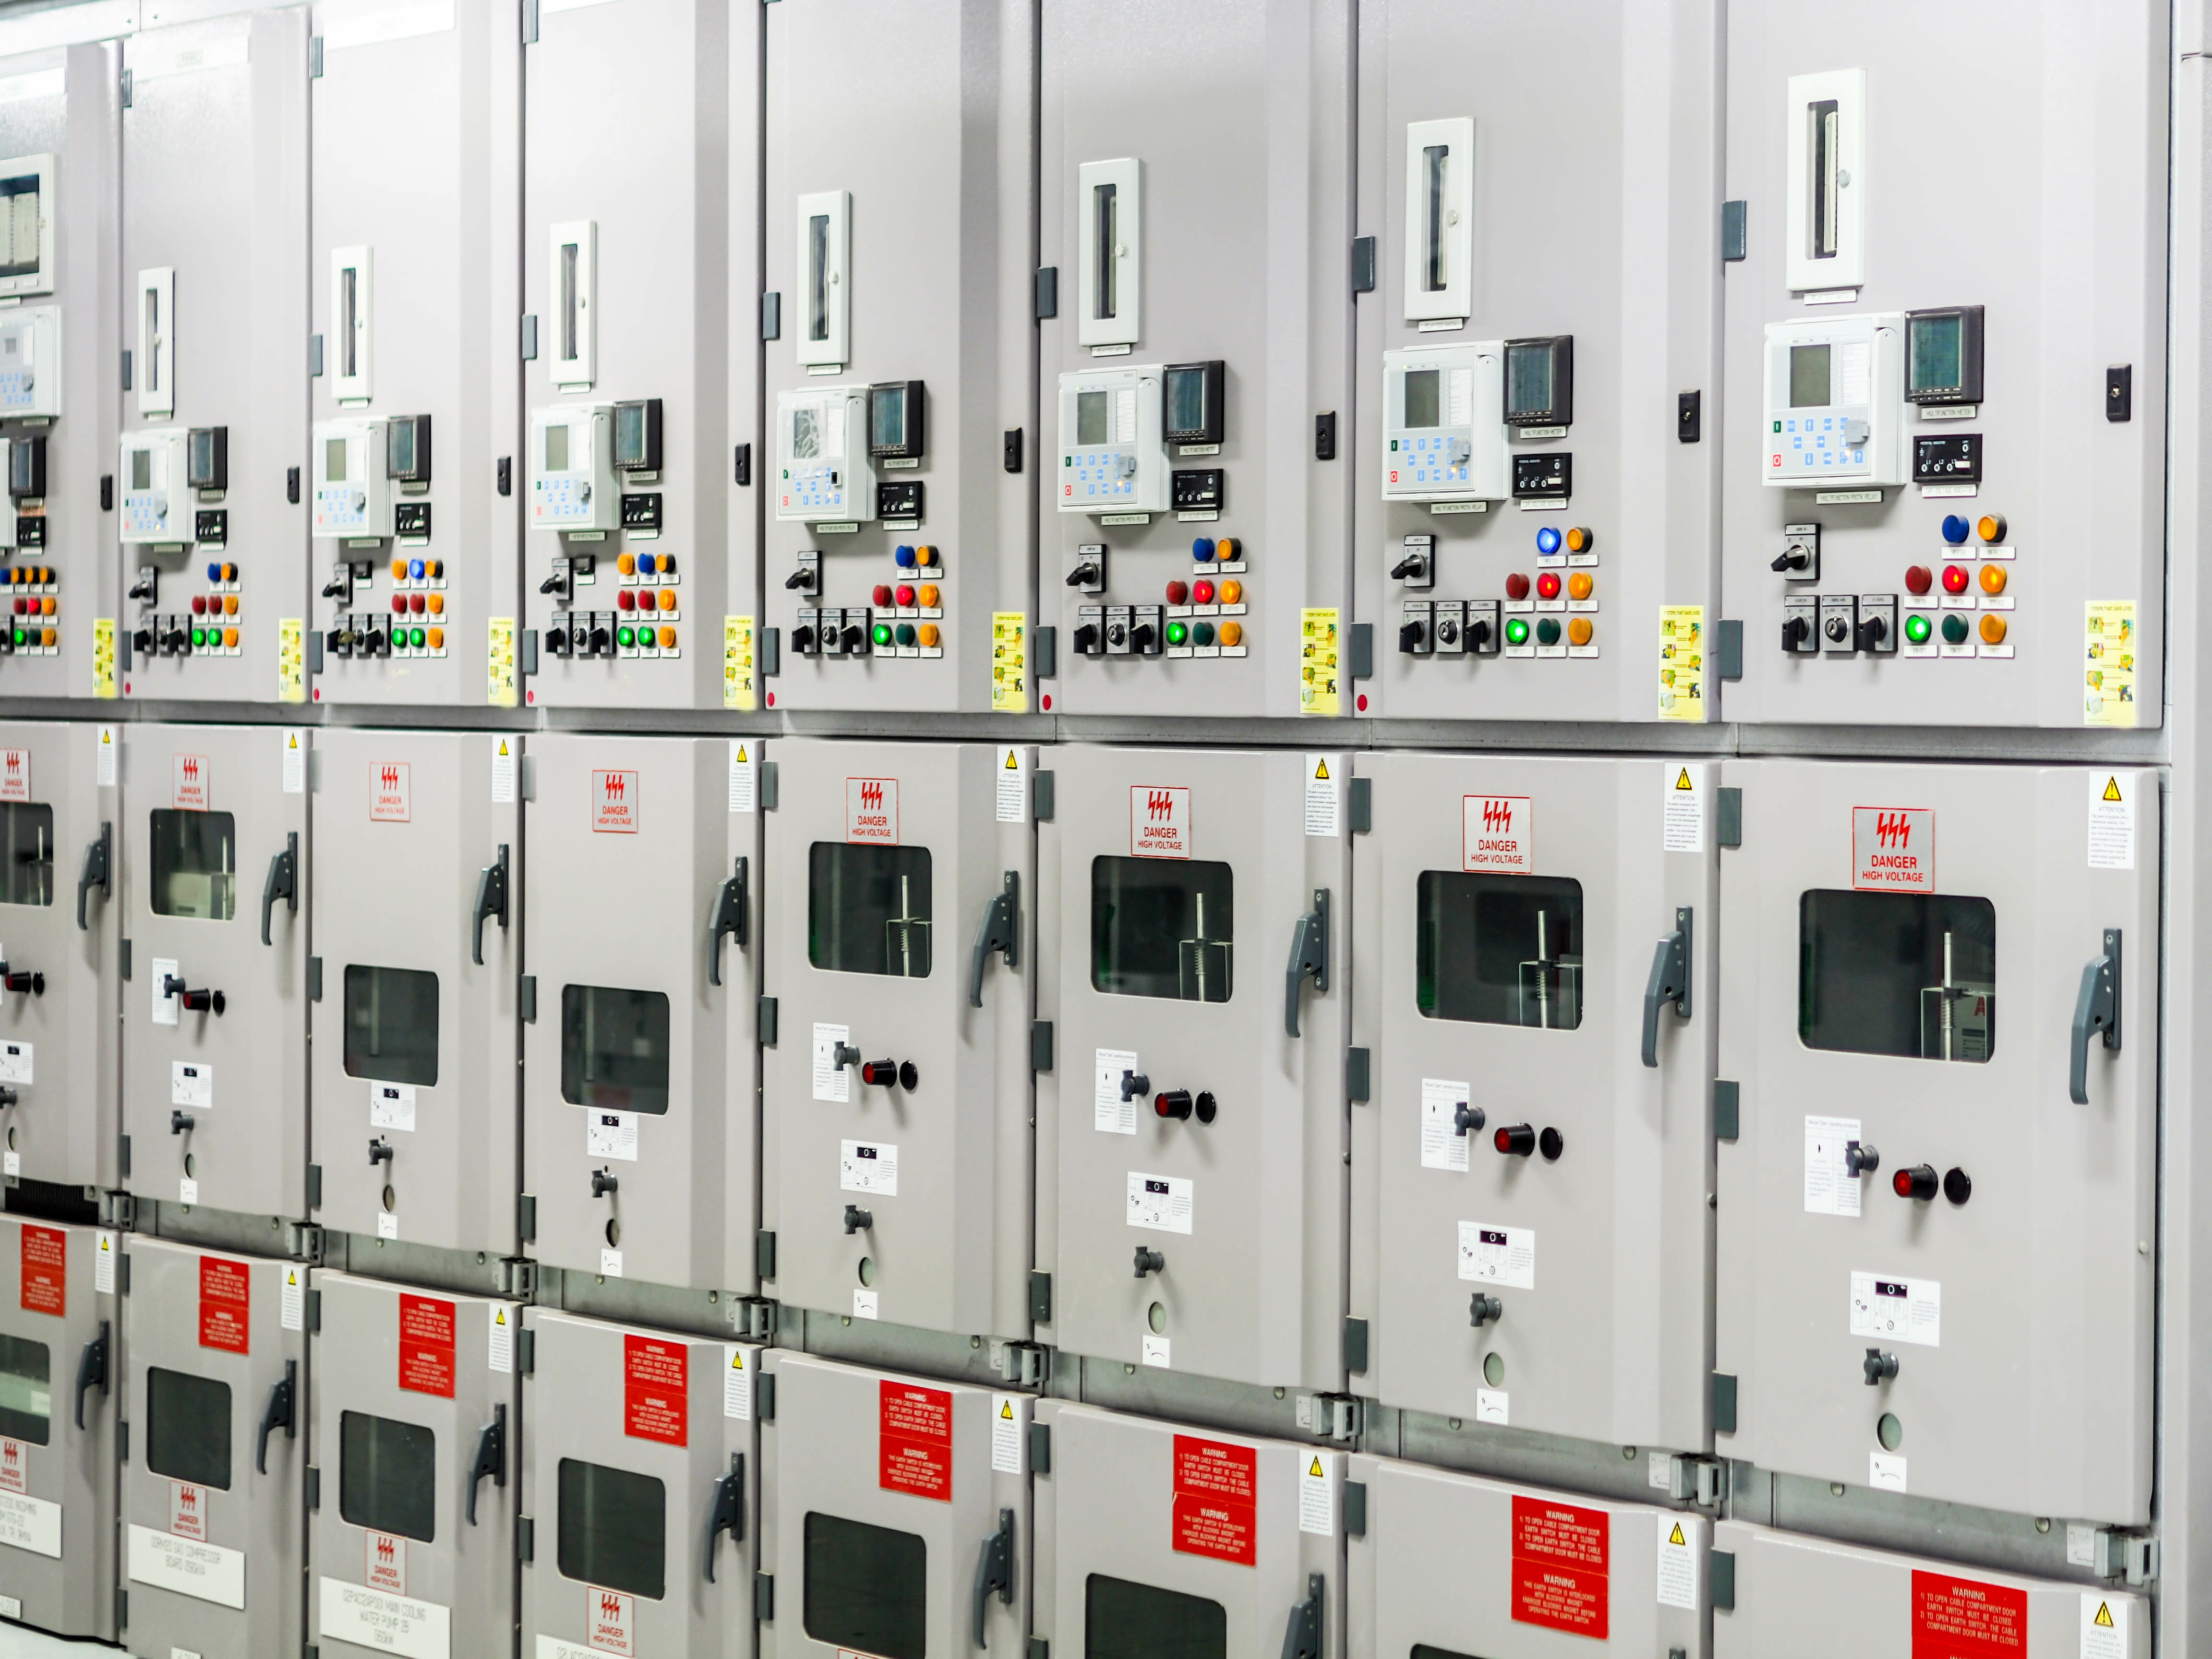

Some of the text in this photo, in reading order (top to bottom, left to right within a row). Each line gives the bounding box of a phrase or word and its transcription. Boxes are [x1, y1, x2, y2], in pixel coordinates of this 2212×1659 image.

[181, 785, 200, 794] DANGER
[379, 796, 401, 805] DANGER
[603, 805, 627, 815] DANGER
[858, 816, 887, 826] DANGER
[1144, 827, 1177, 838] DANGER
[1154, 841, 1182, 850] VOLTAGE
[1479, 840, 1517, 852] DANGER
[1471, 854, 1523, 864] HIGH VOLTAGE
[1872, 855, 1916, 869] DANGER
[1863, 870, 1923, 882] HIGH VOLTAGE
[904, 1392, 926, 1403] WARNING
[903, 1447, 928, 1460] WARNING
[1202, 1447, 1227, 1459] WARNING
[177, 1513, 198, 1524] DANGER
[1201, 1508, 1228, 1522] WARNING
[1546, 1510, 1574, 1523] WARNING
[1525, 1525, 1538, 1534] EARTH
[1541, 1527, 1556, 1537] SWITCH
[1559, 1531, 1569, 1540] MUST
[1532, 1517, 1543, 1526] OPEN
[1544, 1520, 1557, 1528] CABLE
[1558, 1522, 1587, 1534] COMPARTMENT
[1525, 1542, 1554, 1554] COMPARTMENT
[1555, 1548, 1566, 1557] DOOR
[1567, 1551, 1577, 1559] MUST
[1532, 1535, 1543, 1543] OPEN
[1545, 1537, 1558, 1546] EARTH
[1588, 1546, 1600, 1554] CABLE
[1666, 1548, 1688, 1556] ATTENTION
[374, 1565, 397, 1578] DANGER
[1543, 1573, 1575, 1589] WARNING
[1524, 1580, 1532, 1588] THIS
[1534, 1583, 1546, 1591] EARTH
[1548, 1586, 1562, 1595] SWITCH
[1569, 1590, 1595, 1602] INTERLOCKED
[1546, 1593, 1565, 1603] BLOCKING
[1952, 1586, 1986, 1601] WARNING
[1523, 1596, 1596, 1618] ENERGIZE BLOCKING MAGNET BEFORE
[1921, 1592, 2001, 1614] 1) TO OPEN CABLE COMPARTMENT
[360, 1609, 379, 1625] WATER
[381, 1614, 398, 1629] PUMP
[401, 1602, 426, 1622] COOLING
[1528, 1605, 1550, 1616] OPERATING
[1560, 1612, 1573, 1621] EARTH
[1927, 1602, 2013, 1626] EARTH SWITCH MUST BE CLOSED.
[1920, 1611, 1924, 1619] 2)
[1936, 1613, 1948, 1623] OPEN
[1950, 1616, 1966, 1626] EARTH
[1990, 1624, 1999, 1633] THE
[2002, 1626, 2017, 1636] CABLE
[597, 1624, 624, 1638] DANGER
[1927, 1621, 2019, 1647] COMPARTMENT DOOR MUST BE CLOSED.
[2090, 1630, 2117, 1640] ATTENTION
[593, 1635, 627, 1649] HIGH VOLTAGE
